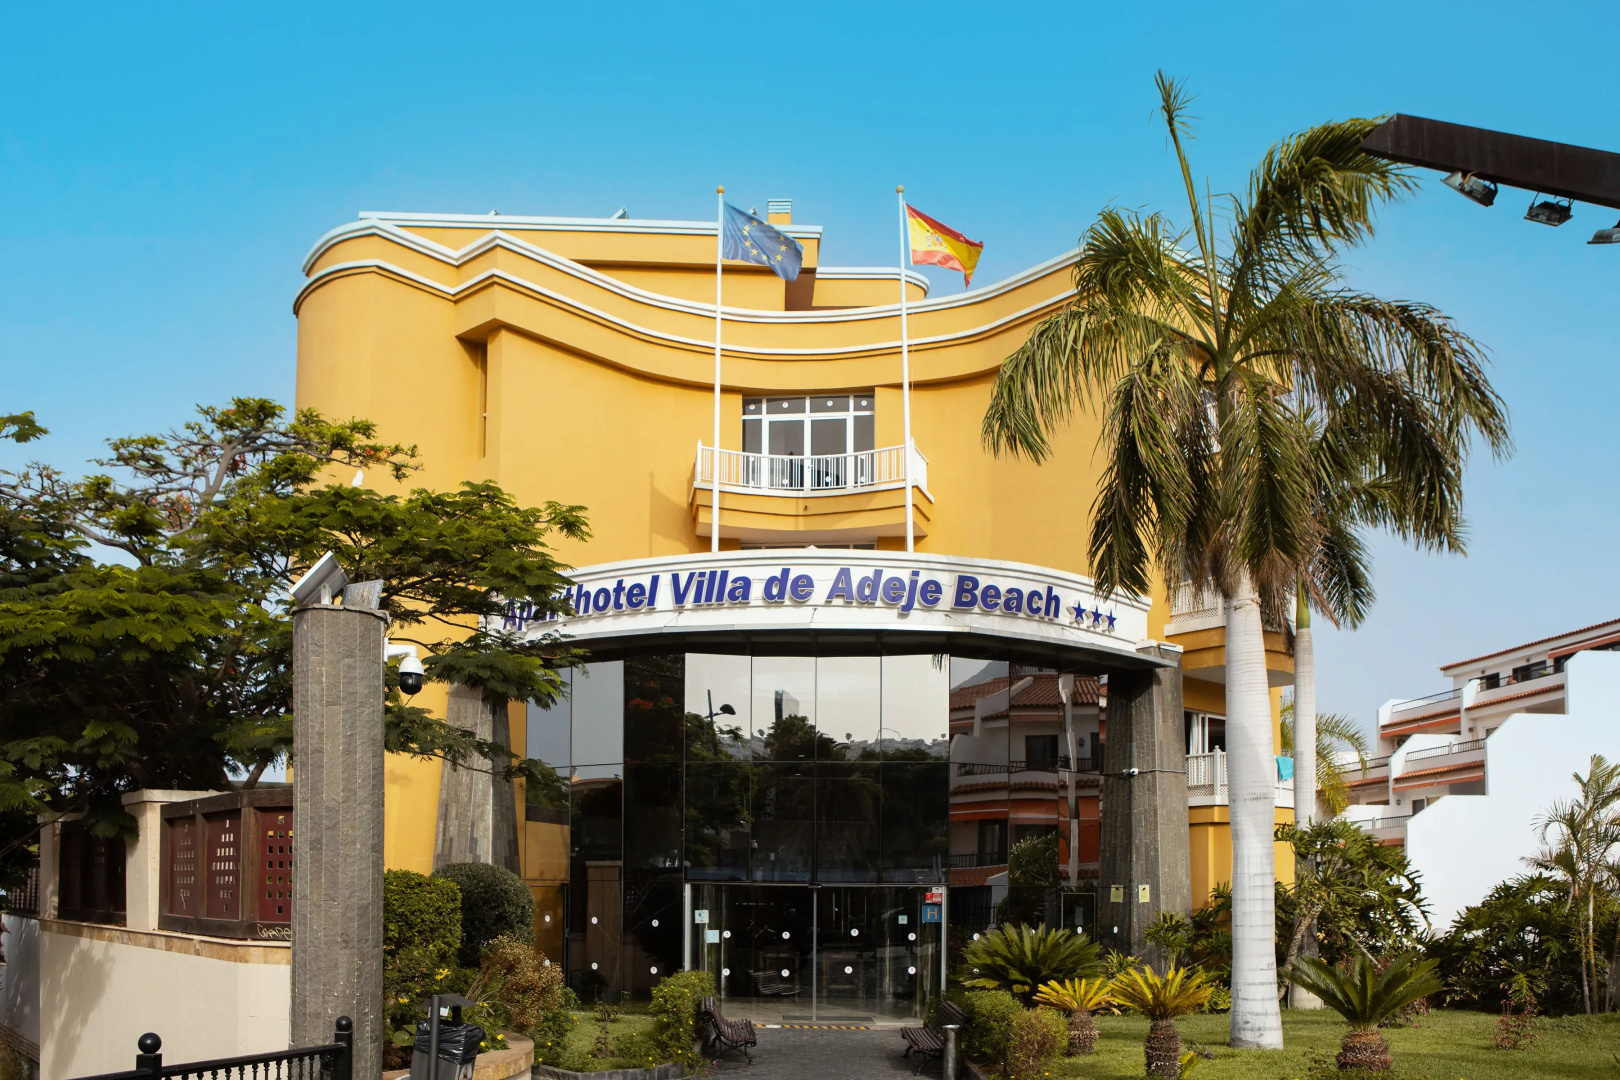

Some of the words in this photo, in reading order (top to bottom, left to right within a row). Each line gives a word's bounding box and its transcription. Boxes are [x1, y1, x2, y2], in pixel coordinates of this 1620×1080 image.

[671, 569, 752, 606] Villa
[764, 567, 814, 601] de
[826, 566, 943, 613] Adeje
[953, 574, 1061, 619] Beach
[927, 907, 938, 920] H
